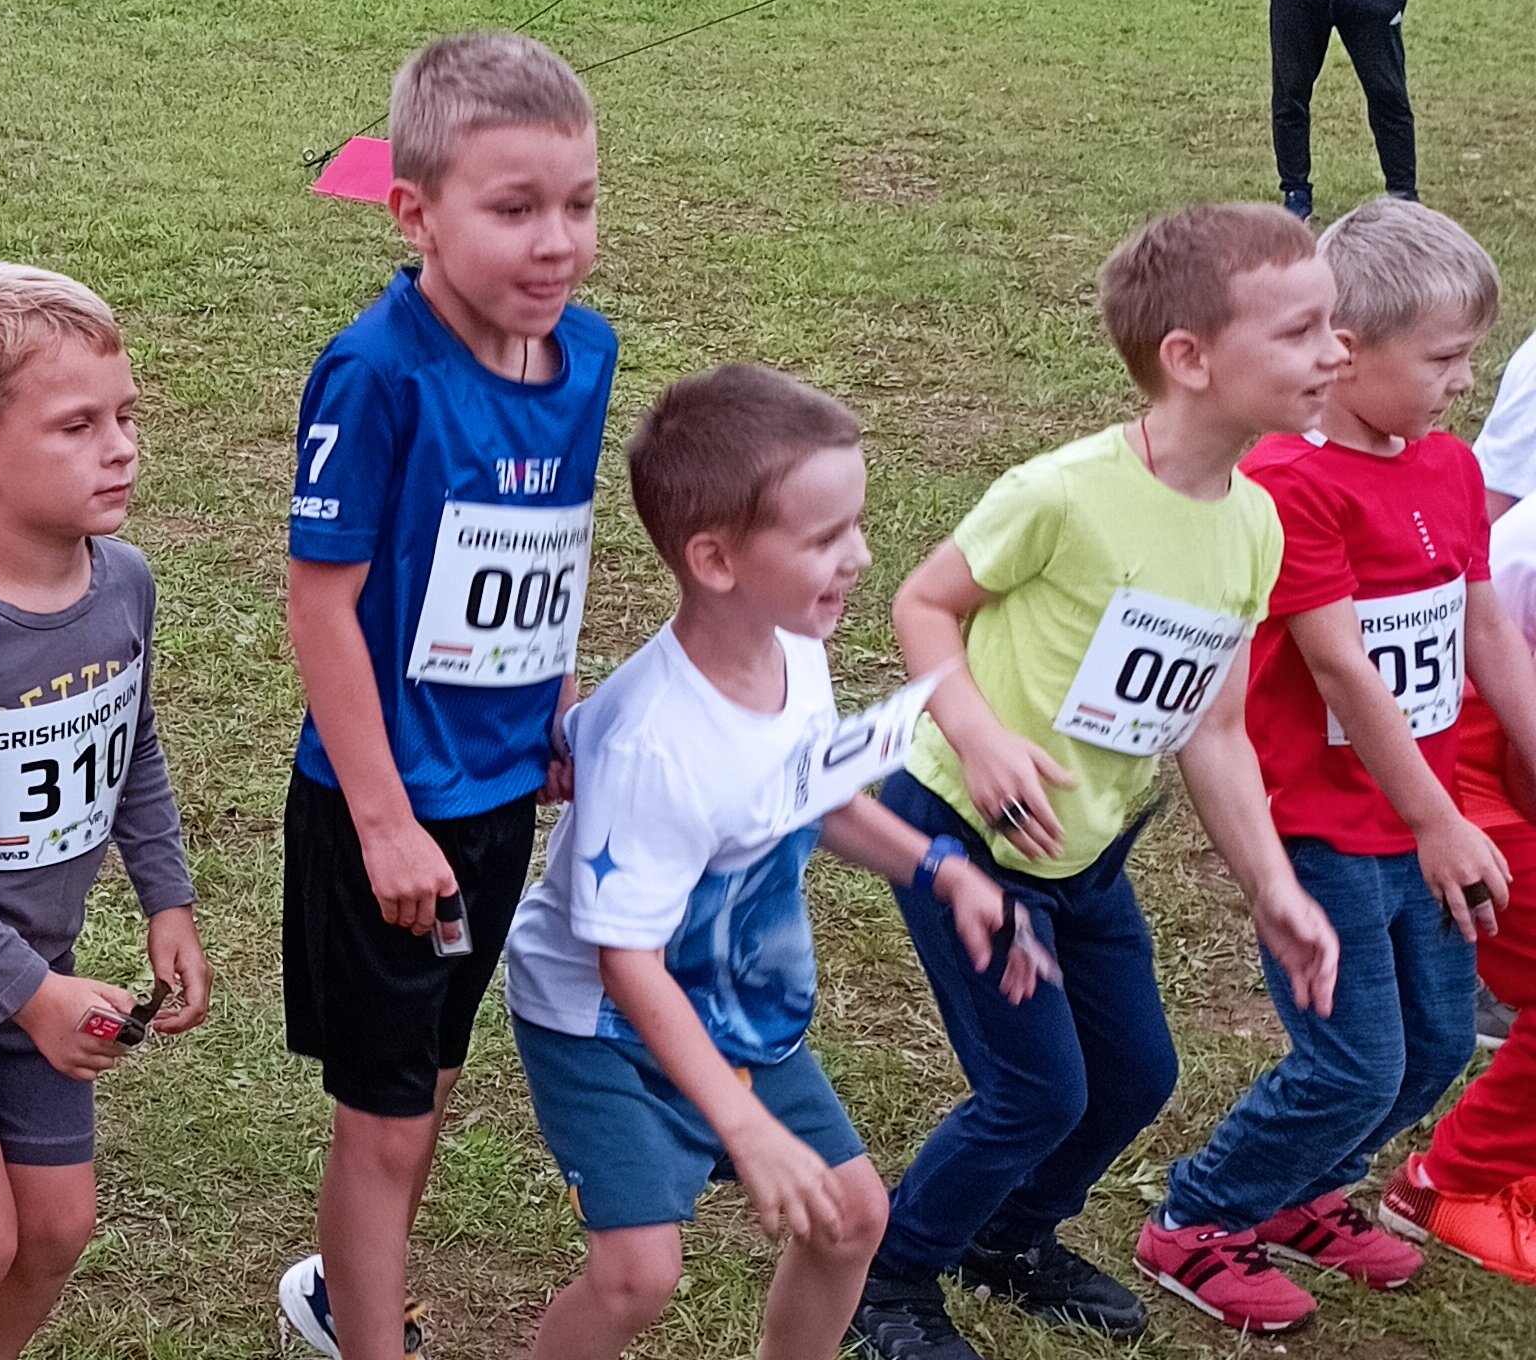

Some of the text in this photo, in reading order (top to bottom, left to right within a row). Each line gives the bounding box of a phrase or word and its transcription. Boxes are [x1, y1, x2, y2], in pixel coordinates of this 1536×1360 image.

[304, 423, 340, 485] 7
[465, 561, 576, 630] 006
[1360, 603, 1448, 635] RISHKINO
[1115, 646, 1220, 716] 008
[1368, 627, 1457, 699] 051
[113, 680, 138, 716] RUN
[19, 721, 128, 823] 310
